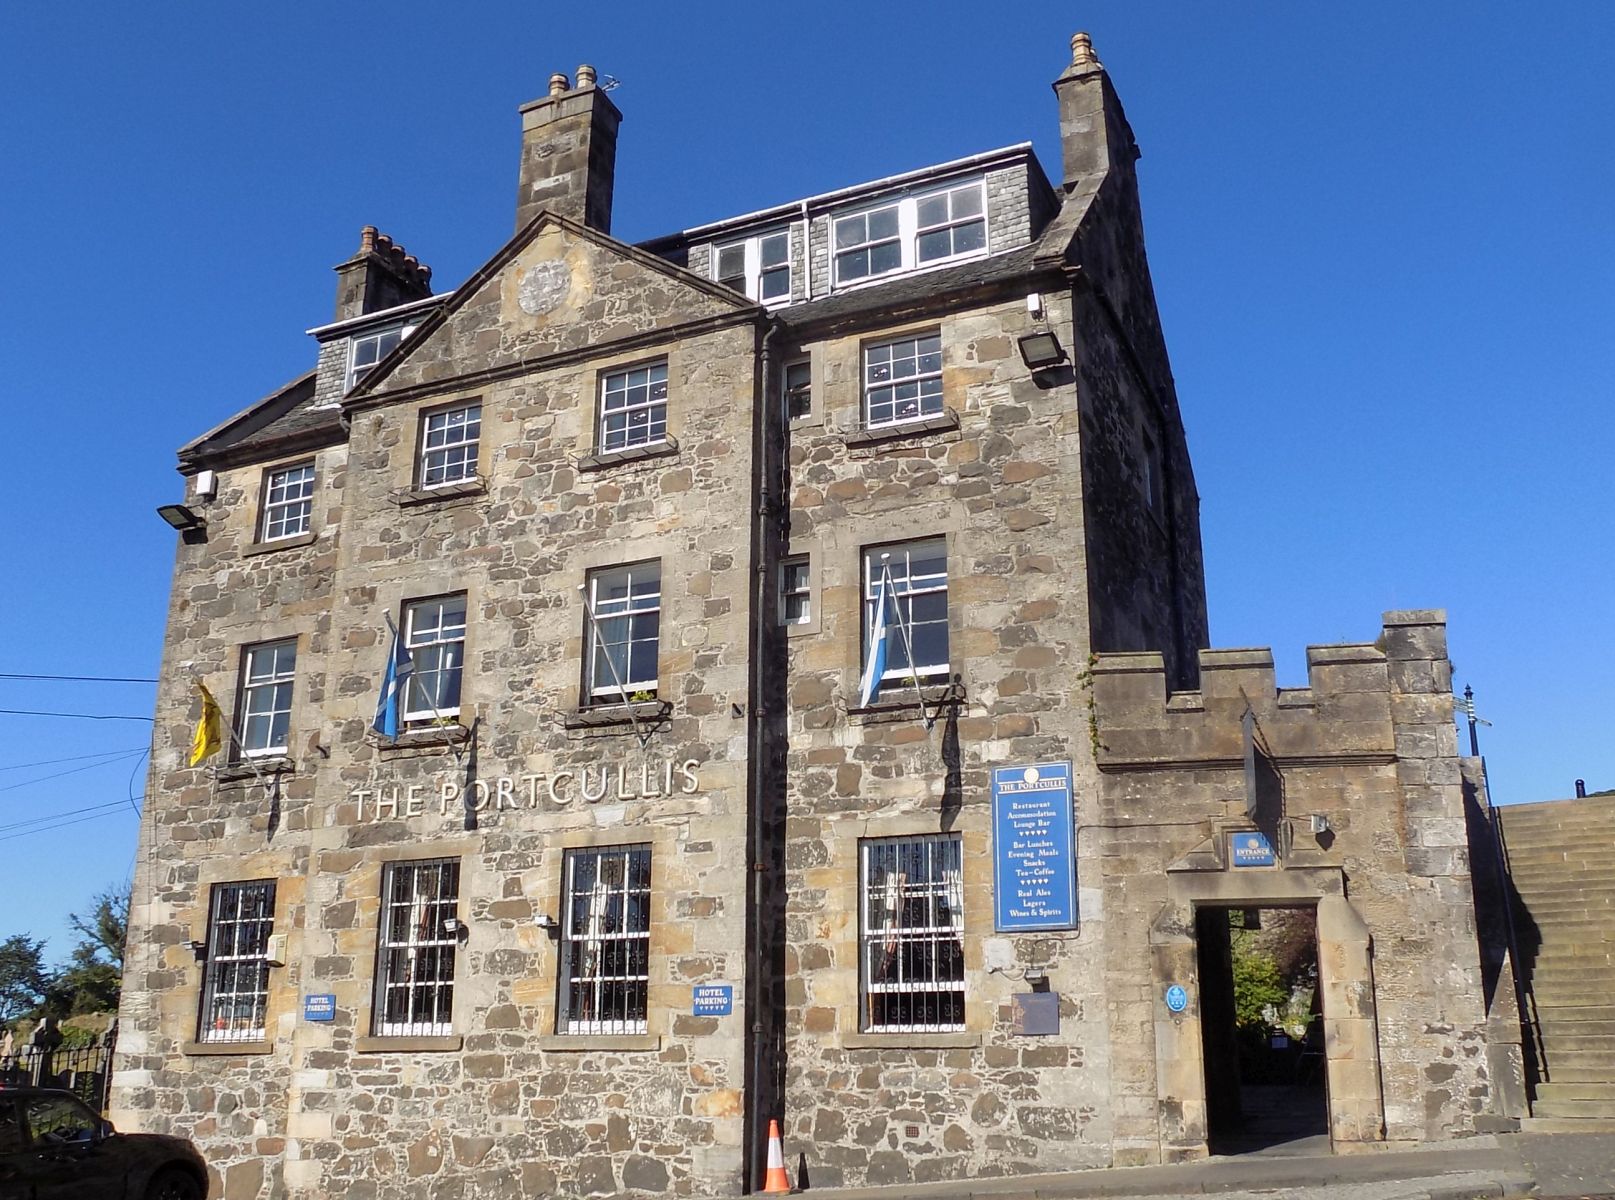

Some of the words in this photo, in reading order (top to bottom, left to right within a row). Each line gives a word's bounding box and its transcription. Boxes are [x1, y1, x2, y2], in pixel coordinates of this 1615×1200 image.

[1018, 779, 1067, 790] PORTCULLIS
[350, 785, 424, 821] THE
[440, 758, 701, 815] PORTCULLIS
[1013, 802, 1050, 810] Restaurant
[1008, 811, 1056, 820] Accommodation
[1013, 841, 1025, 849] Bar
[1023, 859, 1046, 867] Snacks
[1023, 900, 1046, 908] Lagers
[1009, 909, 1029, 917] Wines
[1039, 908, 1061, 918] Spirits
[699, 988, 724, 996] HOTEL
[695, 997, 728, 1005] PARKING
